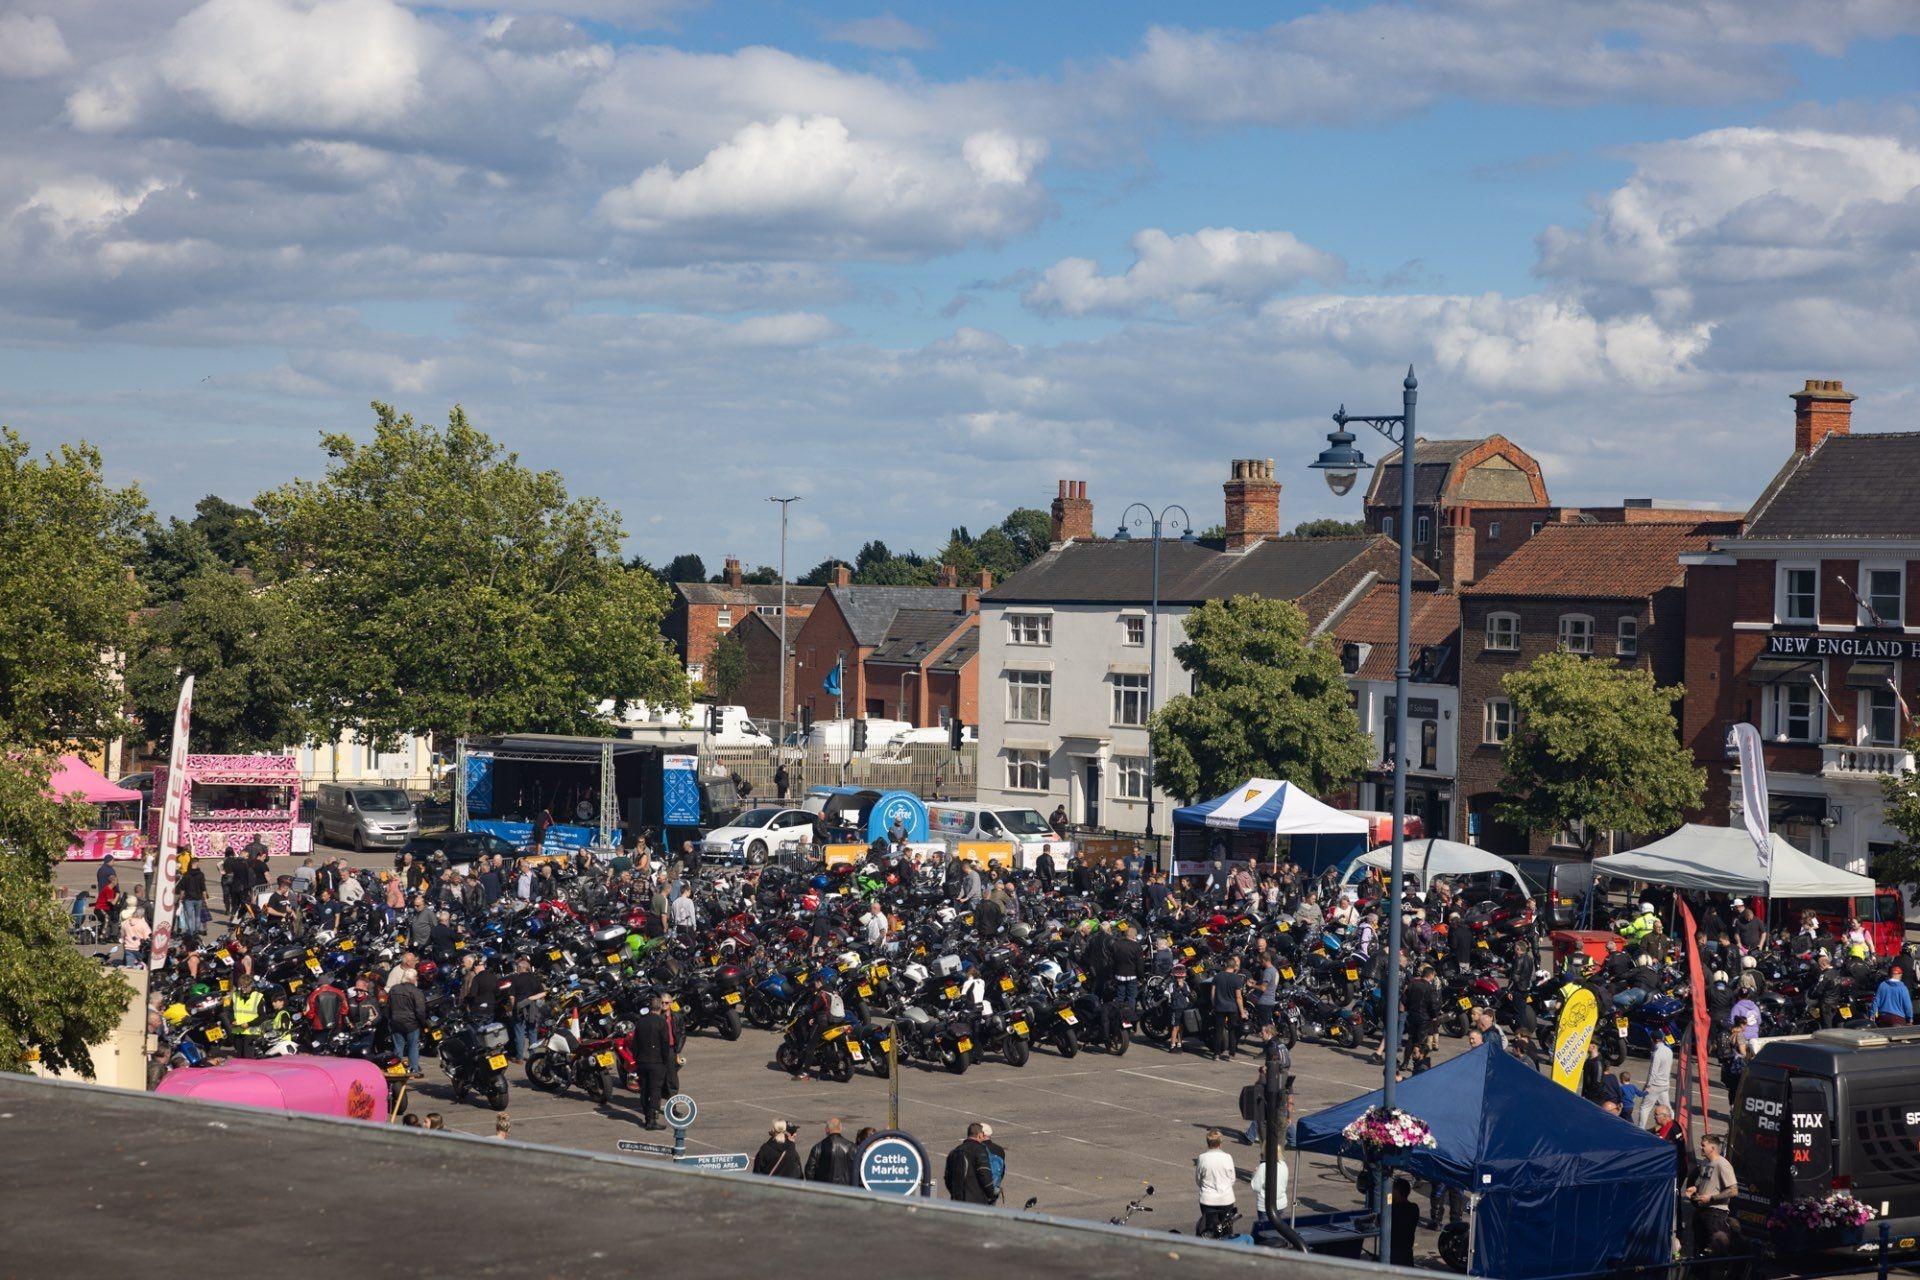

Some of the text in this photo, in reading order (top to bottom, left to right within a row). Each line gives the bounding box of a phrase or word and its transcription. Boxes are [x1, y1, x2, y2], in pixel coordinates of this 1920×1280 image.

[1772, 637, 1811, 653] NEW
[1817, 638, 1904, 657] ENGLAND
[888, 806, 912, 820] Coffee
[162, 749, 184, 912] COFFEE
[1556, 1031, 1578, 1060] Boston
[1560, 1025, 1593, 1067] Motorcycle
[1565, 1049, 1585, 1075] Riders
[871, 1165, 909, 1175] Market
[874, 1154, 907, 1163] Cattle
